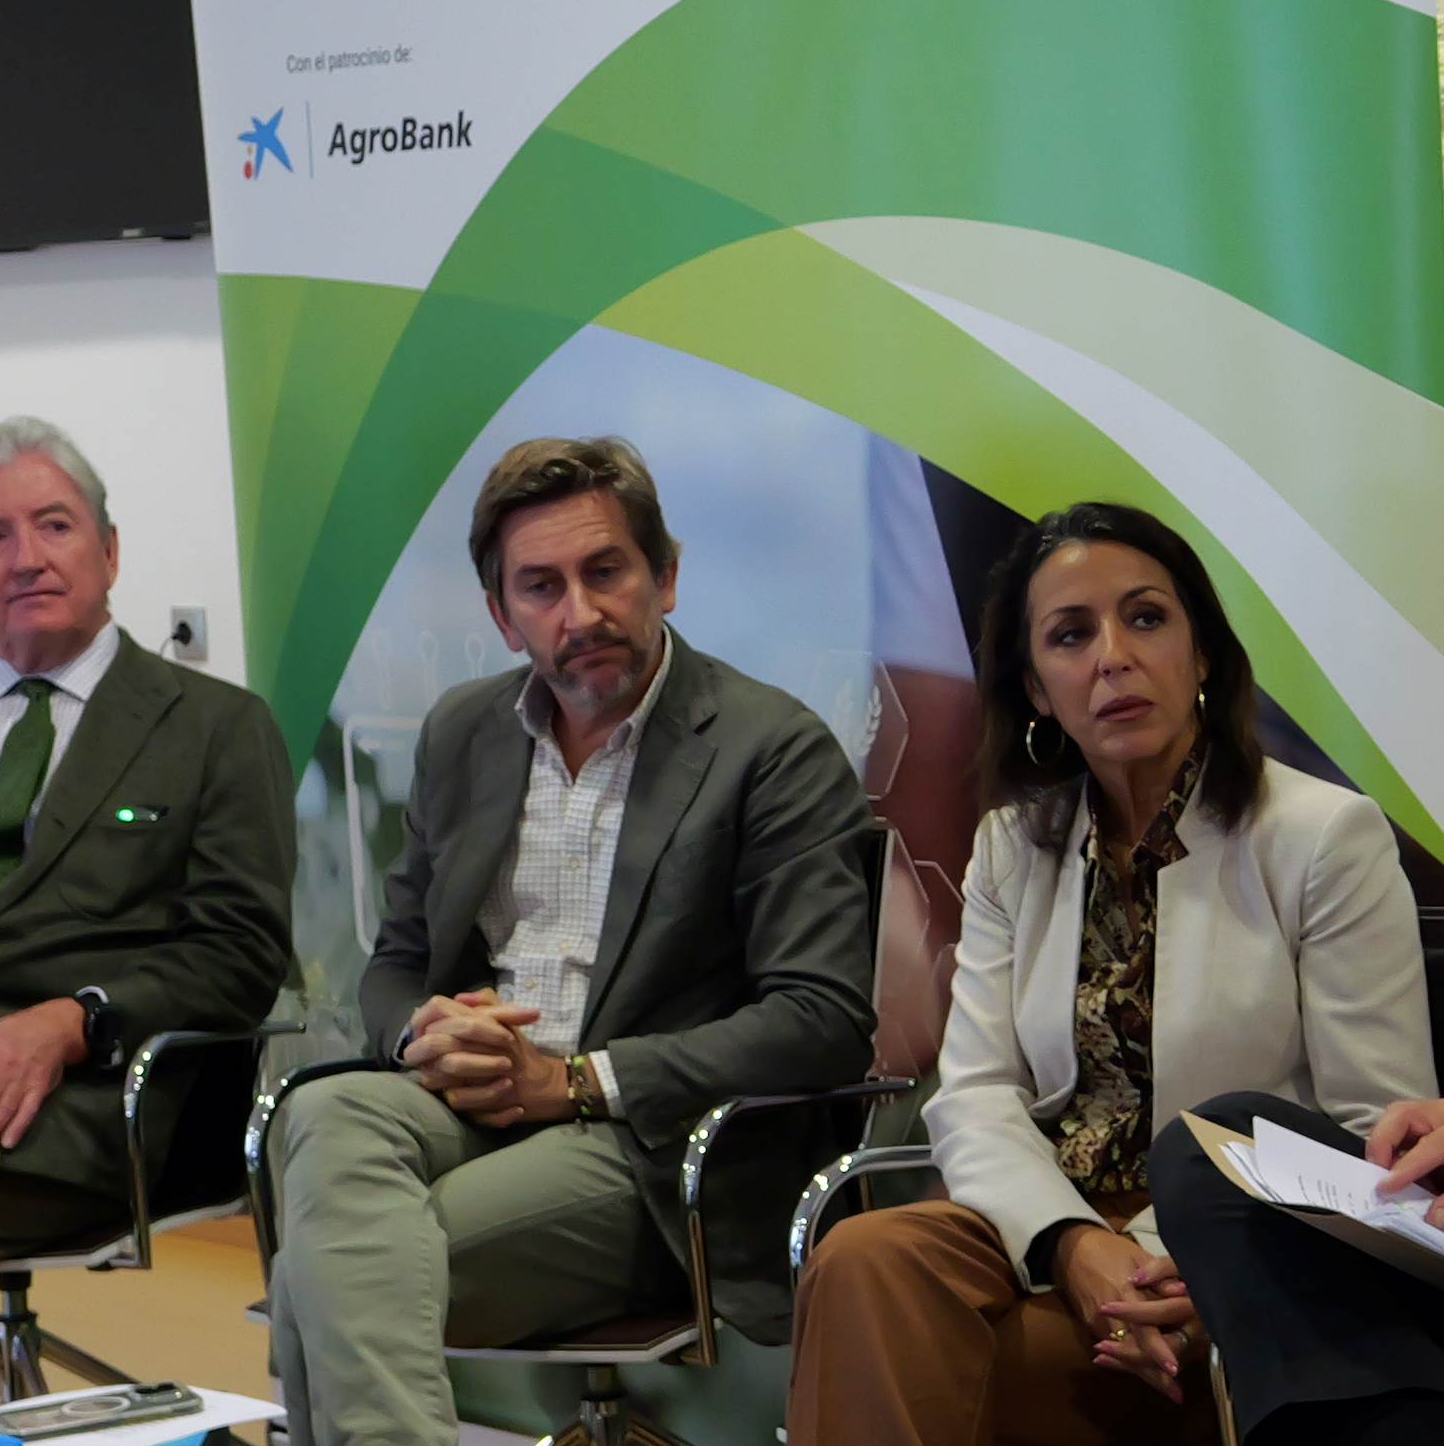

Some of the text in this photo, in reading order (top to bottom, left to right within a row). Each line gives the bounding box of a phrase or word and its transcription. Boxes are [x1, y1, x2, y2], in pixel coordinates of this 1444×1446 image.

[286, 54, 312, 73] Con
[328, 46, 391, 73] patrocinio
[328, 110, 473, 165] AgroBank
